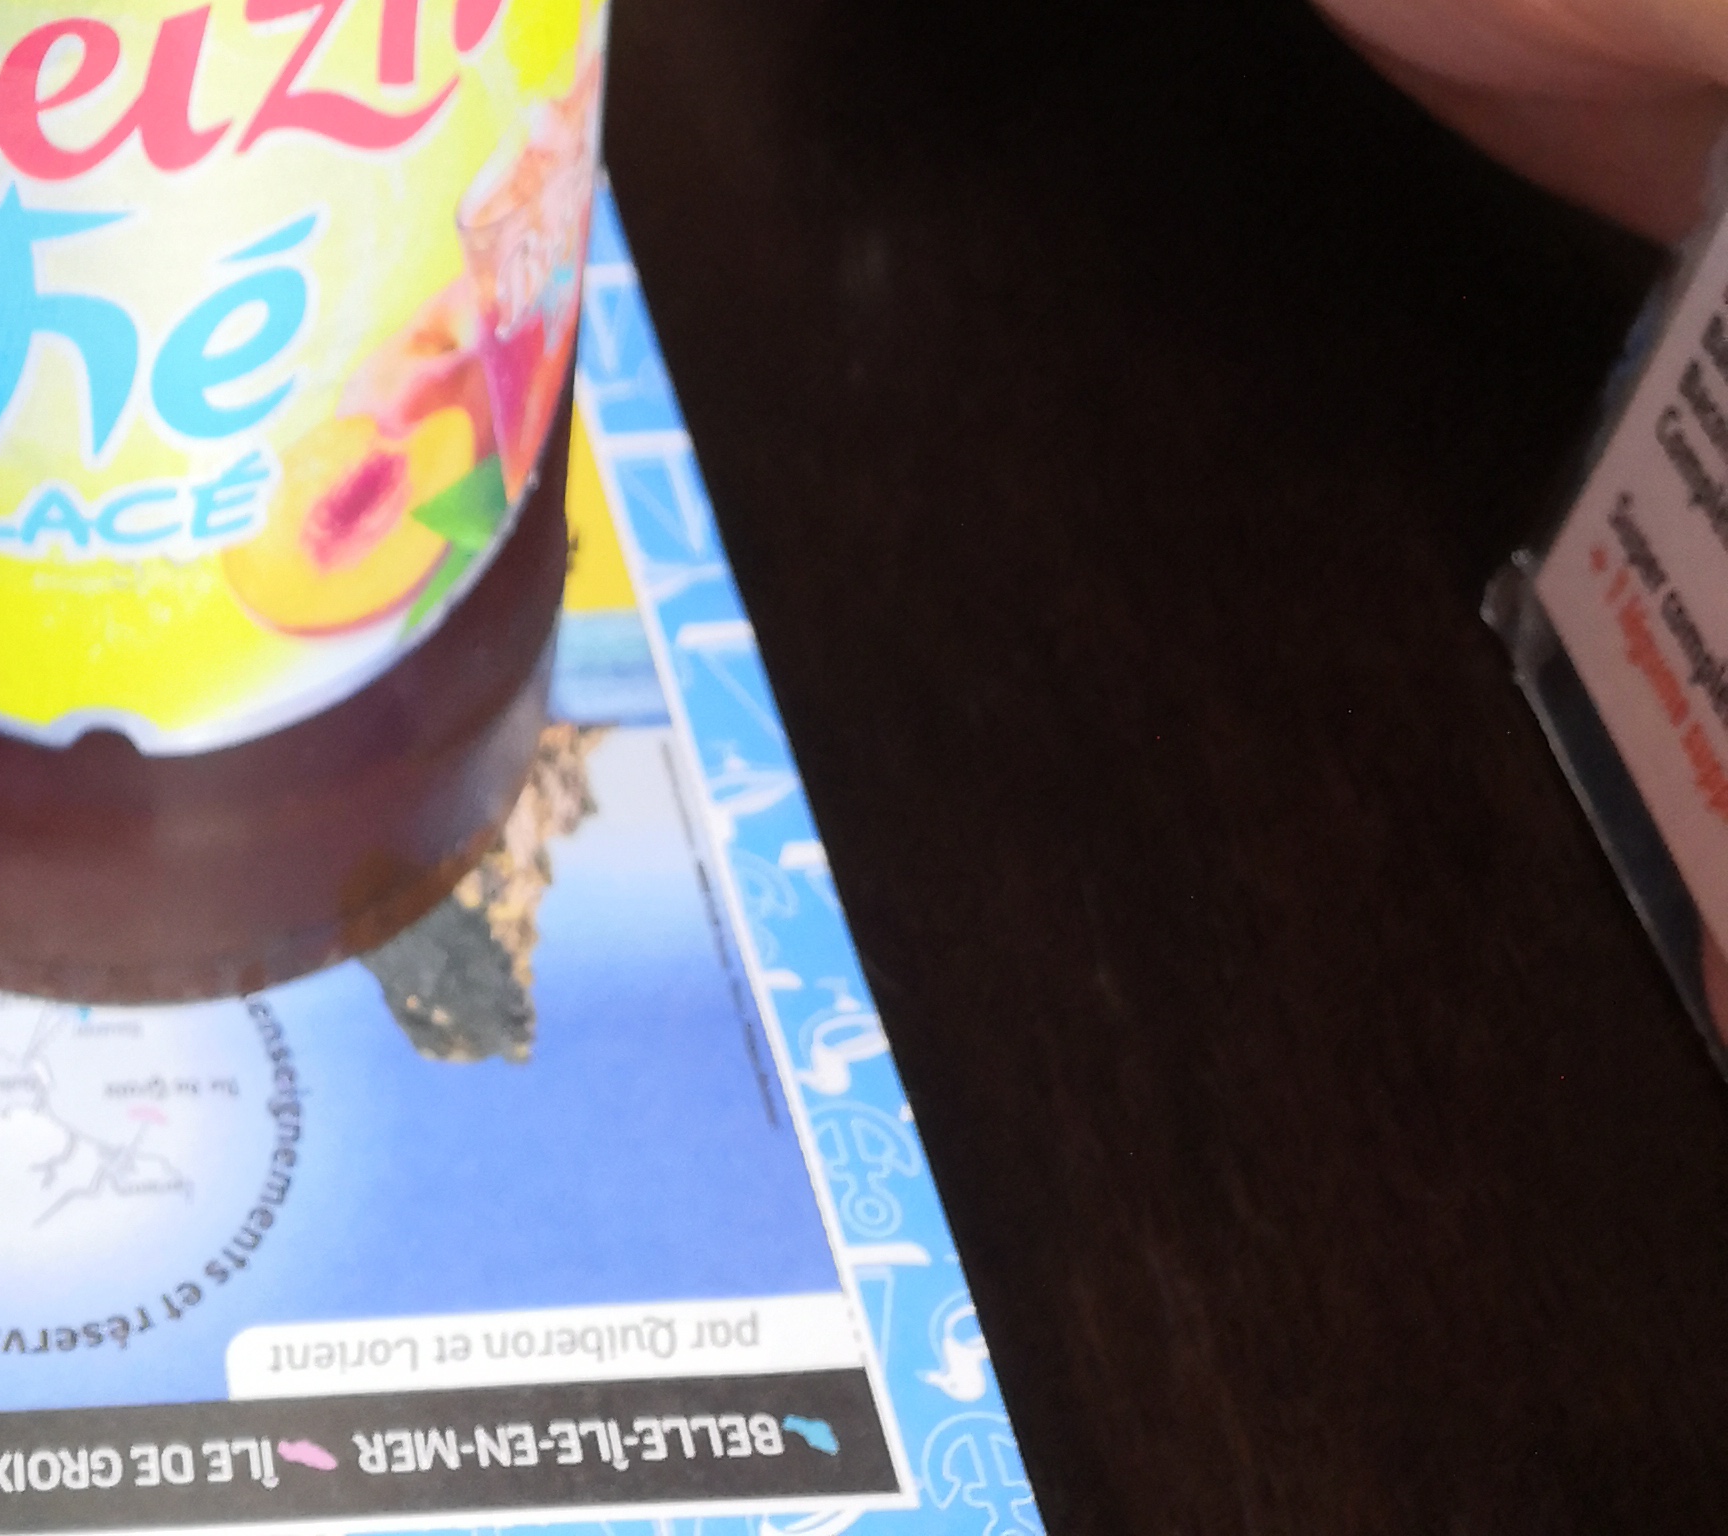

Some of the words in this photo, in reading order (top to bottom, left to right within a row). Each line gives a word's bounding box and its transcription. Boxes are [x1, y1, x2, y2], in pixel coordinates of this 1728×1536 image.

[203, 998, 304, 1286] enseignements
[161, 1280, 202, 1322] et
[433, 1333, 471, 1369] et
[485, 1316, 677, 1367] Quiberon
[690, 1311, 760, 1352] par
[267, 1337, 420, 1377] Lorient
[129, 1441, 195, 1487] DE
[201, 1435, 279, 1489] ÎLE
[351, 1411, 783, 1474] BELLE-ÎLE-EN-MER
